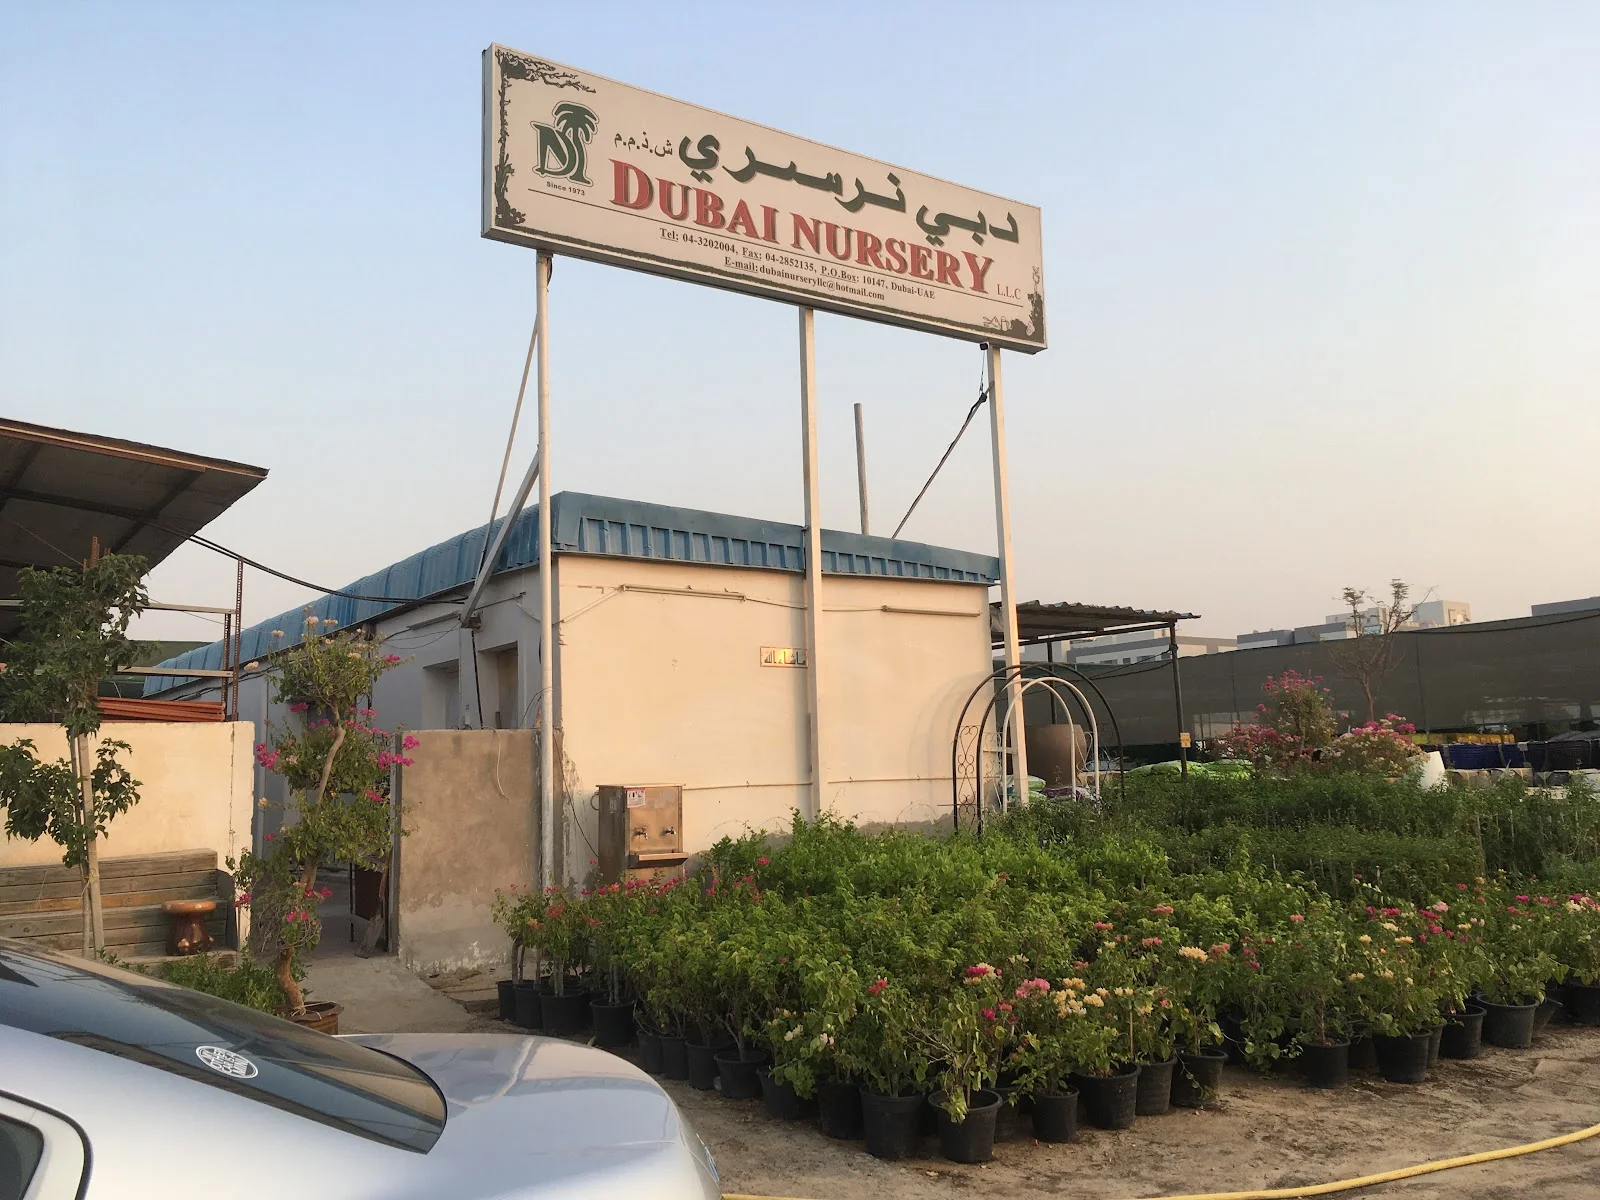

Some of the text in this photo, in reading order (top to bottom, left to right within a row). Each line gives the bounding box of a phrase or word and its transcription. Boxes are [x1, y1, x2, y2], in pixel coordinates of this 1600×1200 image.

[546, 181, 586, 196] Since 1973
[678, 134, 907, 213] نرسري
[608, 158, 780, 245] DUBAI
[790, 212, 995, 295] NURSERY
[916, 204, 1019, 247] دبي
[659, 227, 936, 299] Tel: 04-3202004, Fax: 04-2852135, P.O.Box: 10147, Dubai-UAE
[724, 256, 885, 300] E-mail: dubainurseryllc@hotmail.com
